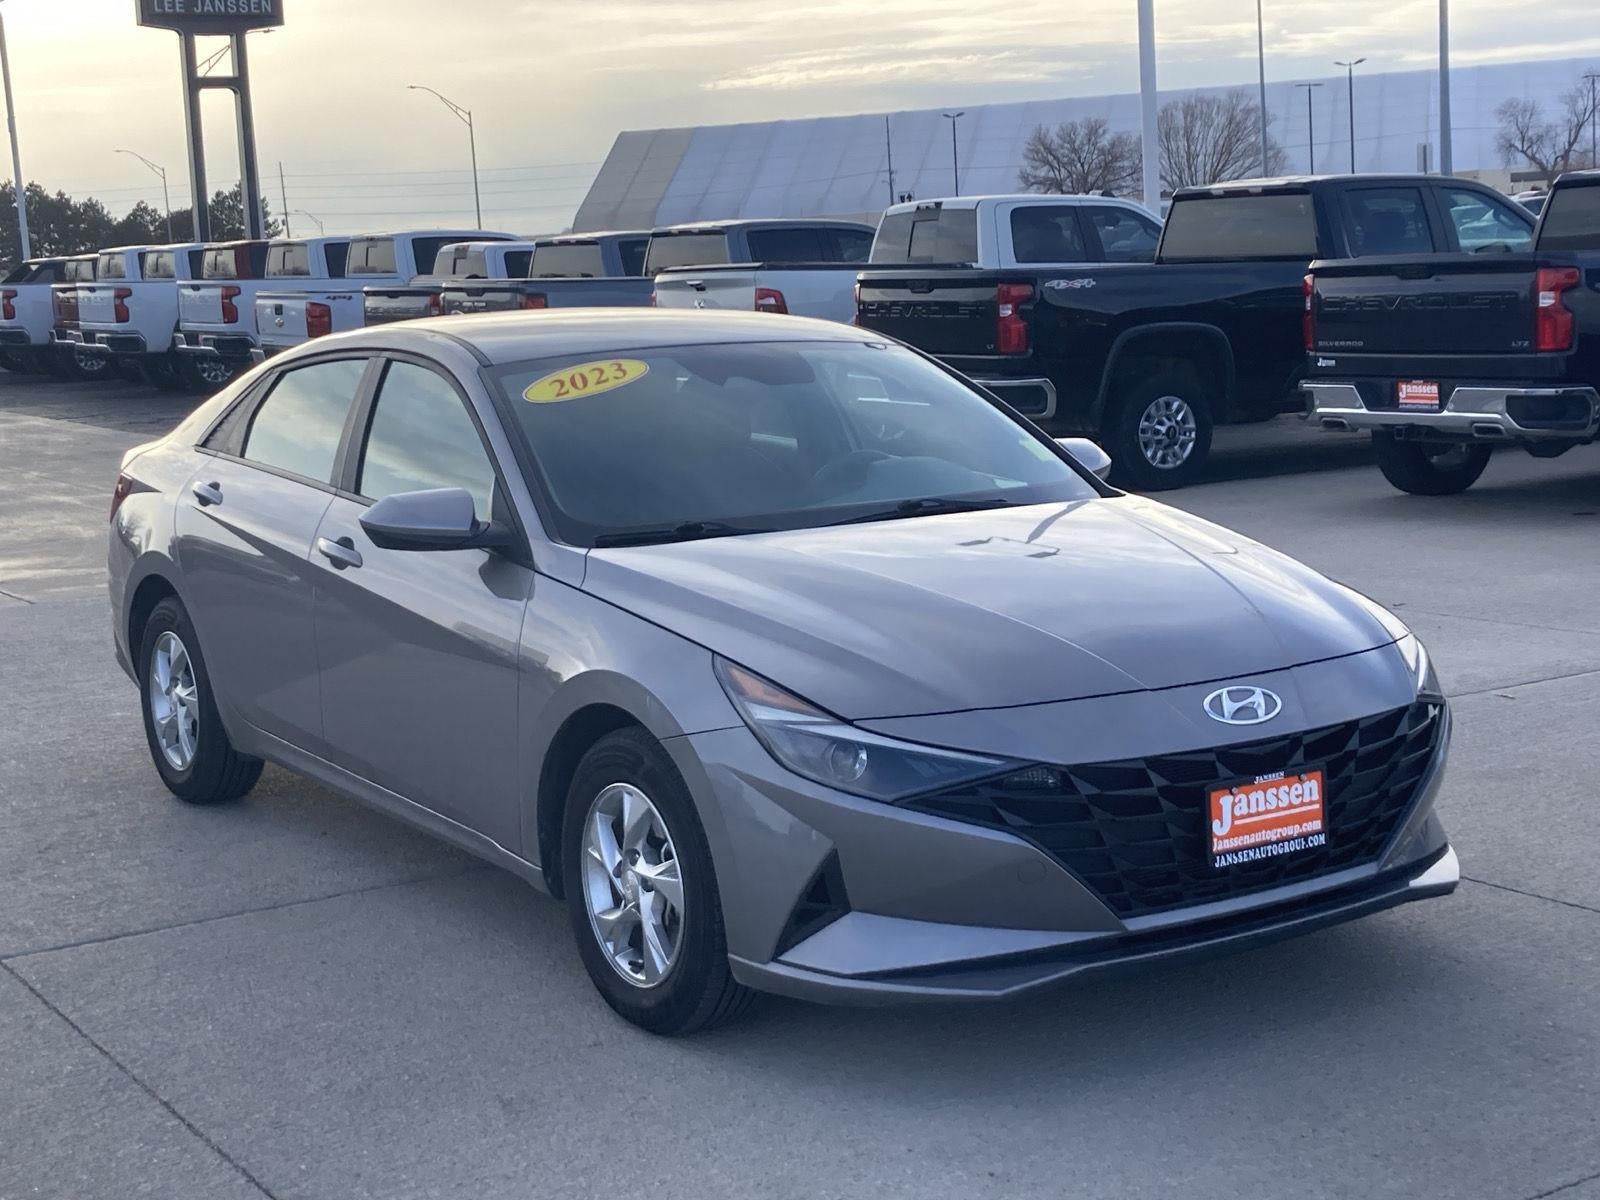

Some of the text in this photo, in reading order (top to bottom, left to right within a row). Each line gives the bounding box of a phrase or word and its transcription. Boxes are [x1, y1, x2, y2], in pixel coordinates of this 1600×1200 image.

[154, 0, 272, 13] LEE JANSSEN
[1323, 293, 1516, 311] CHEVROLET
[549, 362, 627, 397] 2023
[1399, 383, 1438, 398] Janssen
[1212, 779, 1319, 835] Janssen
[1212, 819, 1322, 852] Janssenautogroup.com
[1215, 833, 1326, 868] JANSSENAUTOGROUP.COM
